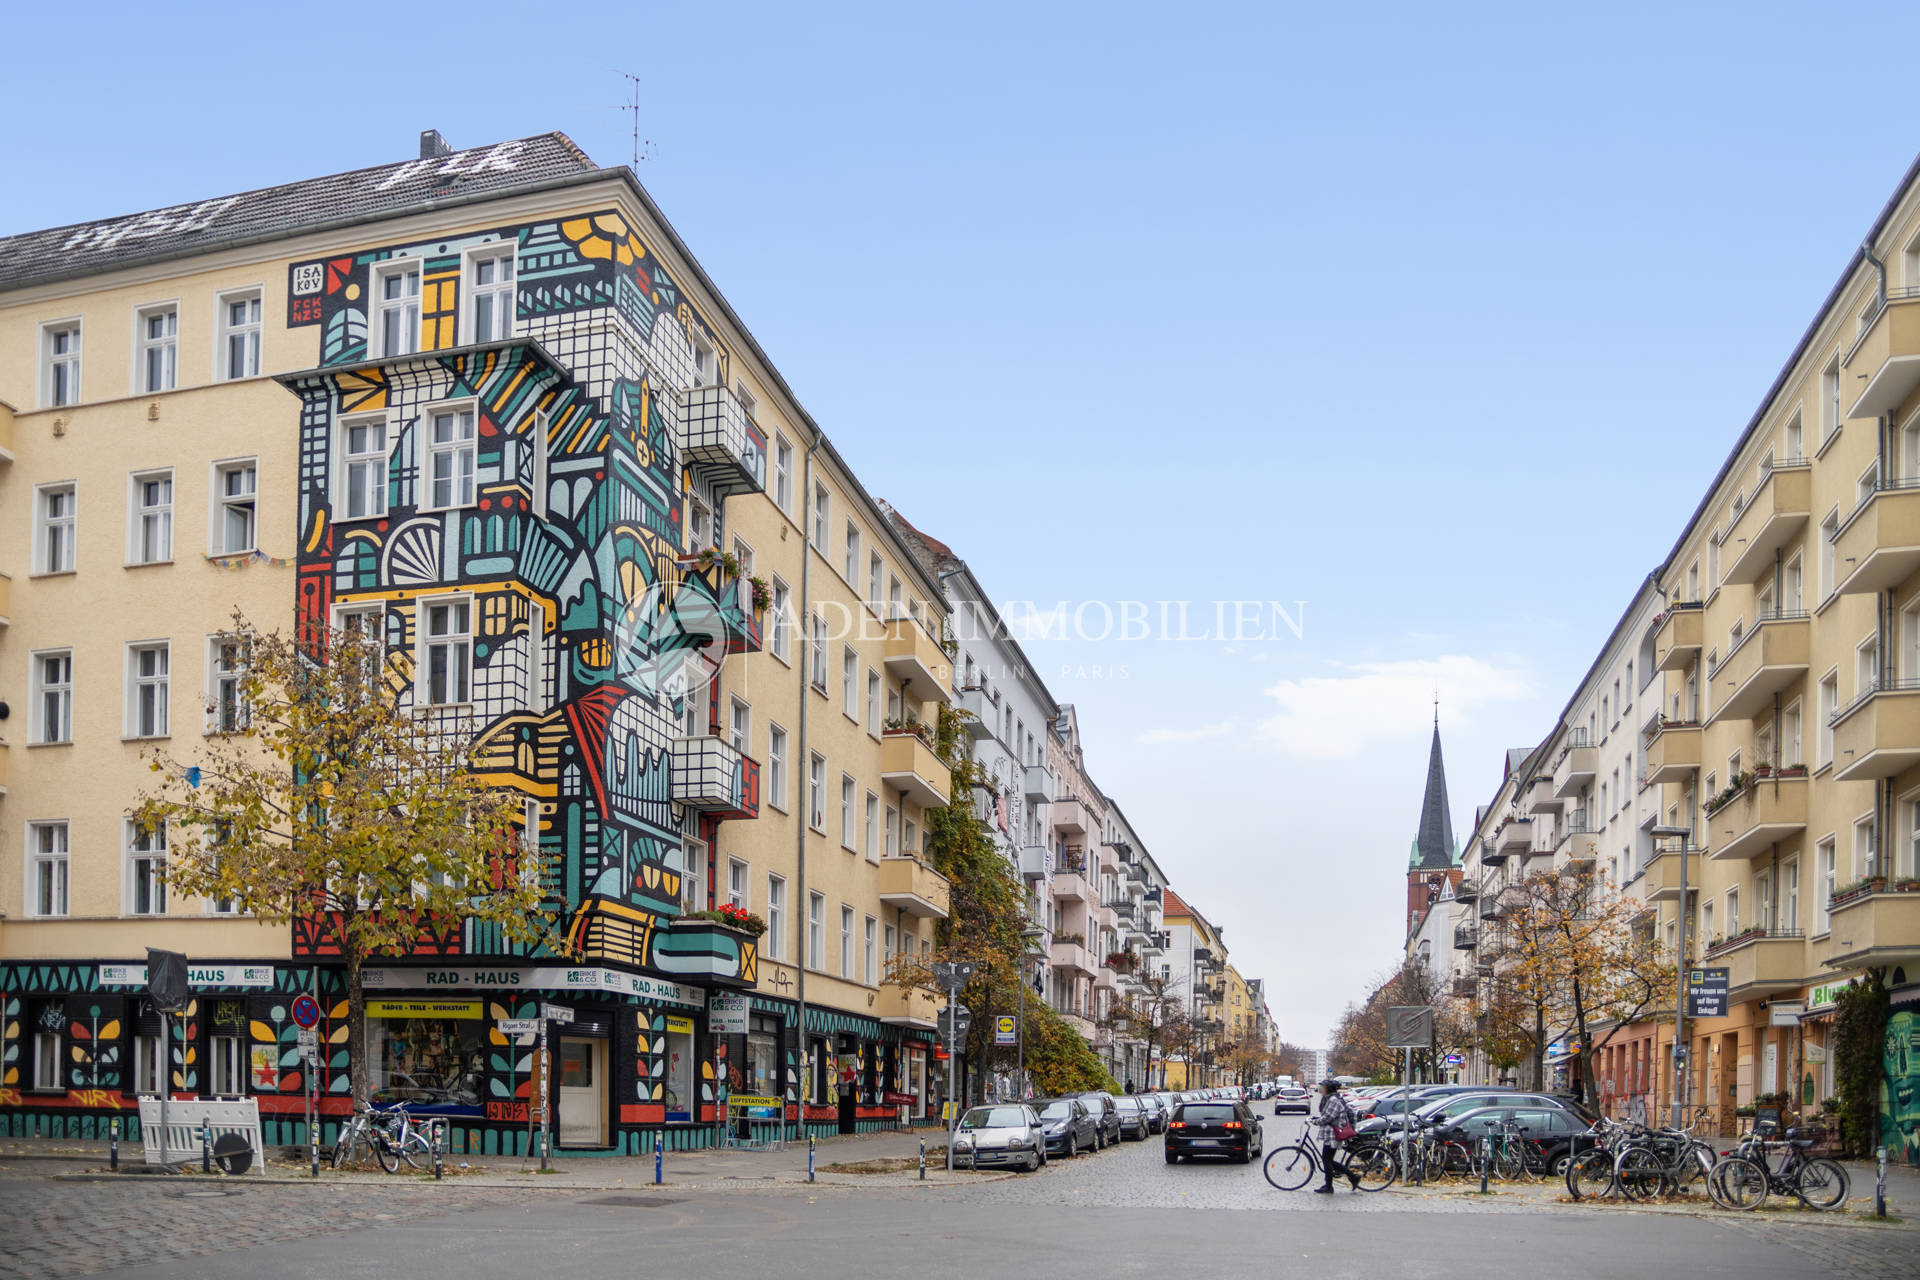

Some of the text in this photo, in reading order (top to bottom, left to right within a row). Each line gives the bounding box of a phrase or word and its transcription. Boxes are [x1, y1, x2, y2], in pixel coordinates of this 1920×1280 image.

[297, 266, 321, 280] ISA
[293, 296, 322, 311] FCK
[293, 308, 322, 323] NZS
[187, 970, 225, 982] HAUS
[426, 972, 460, 984] RAD
[474, 972, 520, 984] HAUS
[632, 979, 651, 993] RAD
[657, 984, 681, 999] HAUS
